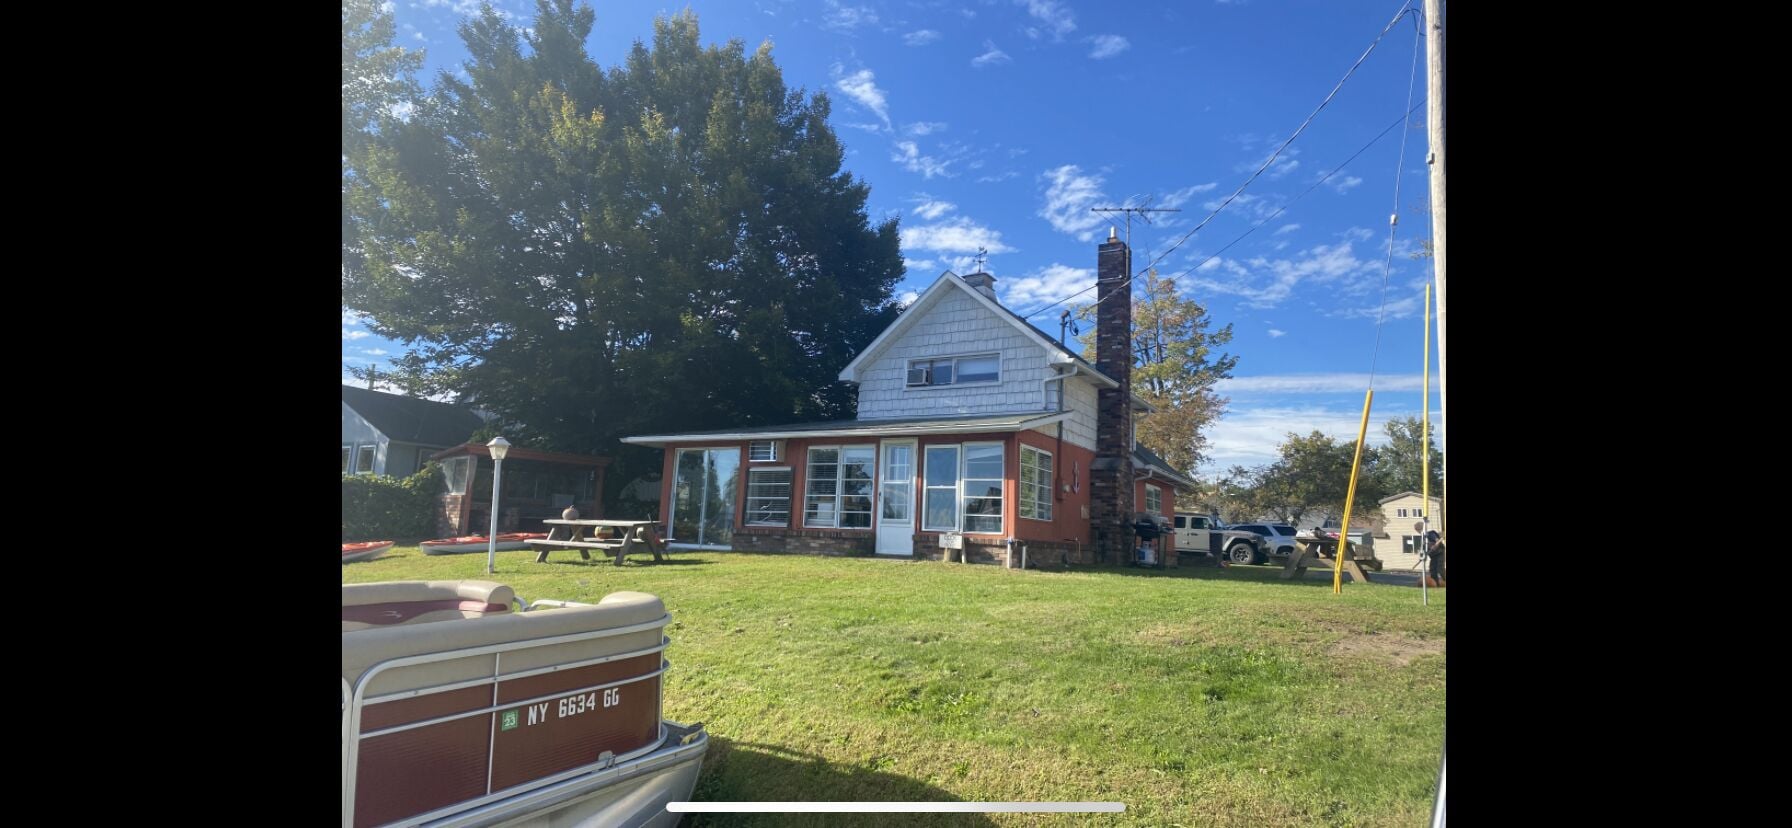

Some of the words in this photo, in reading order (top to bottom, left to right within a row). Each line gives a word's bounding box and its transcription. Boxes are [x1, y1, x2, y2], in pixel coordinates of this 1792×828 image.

[528, 703, 549, 725] NY
[558, 693, 596, 718] 6634
[603, 688, 620, 708] GG
[504, 716, 516, 727] 23
